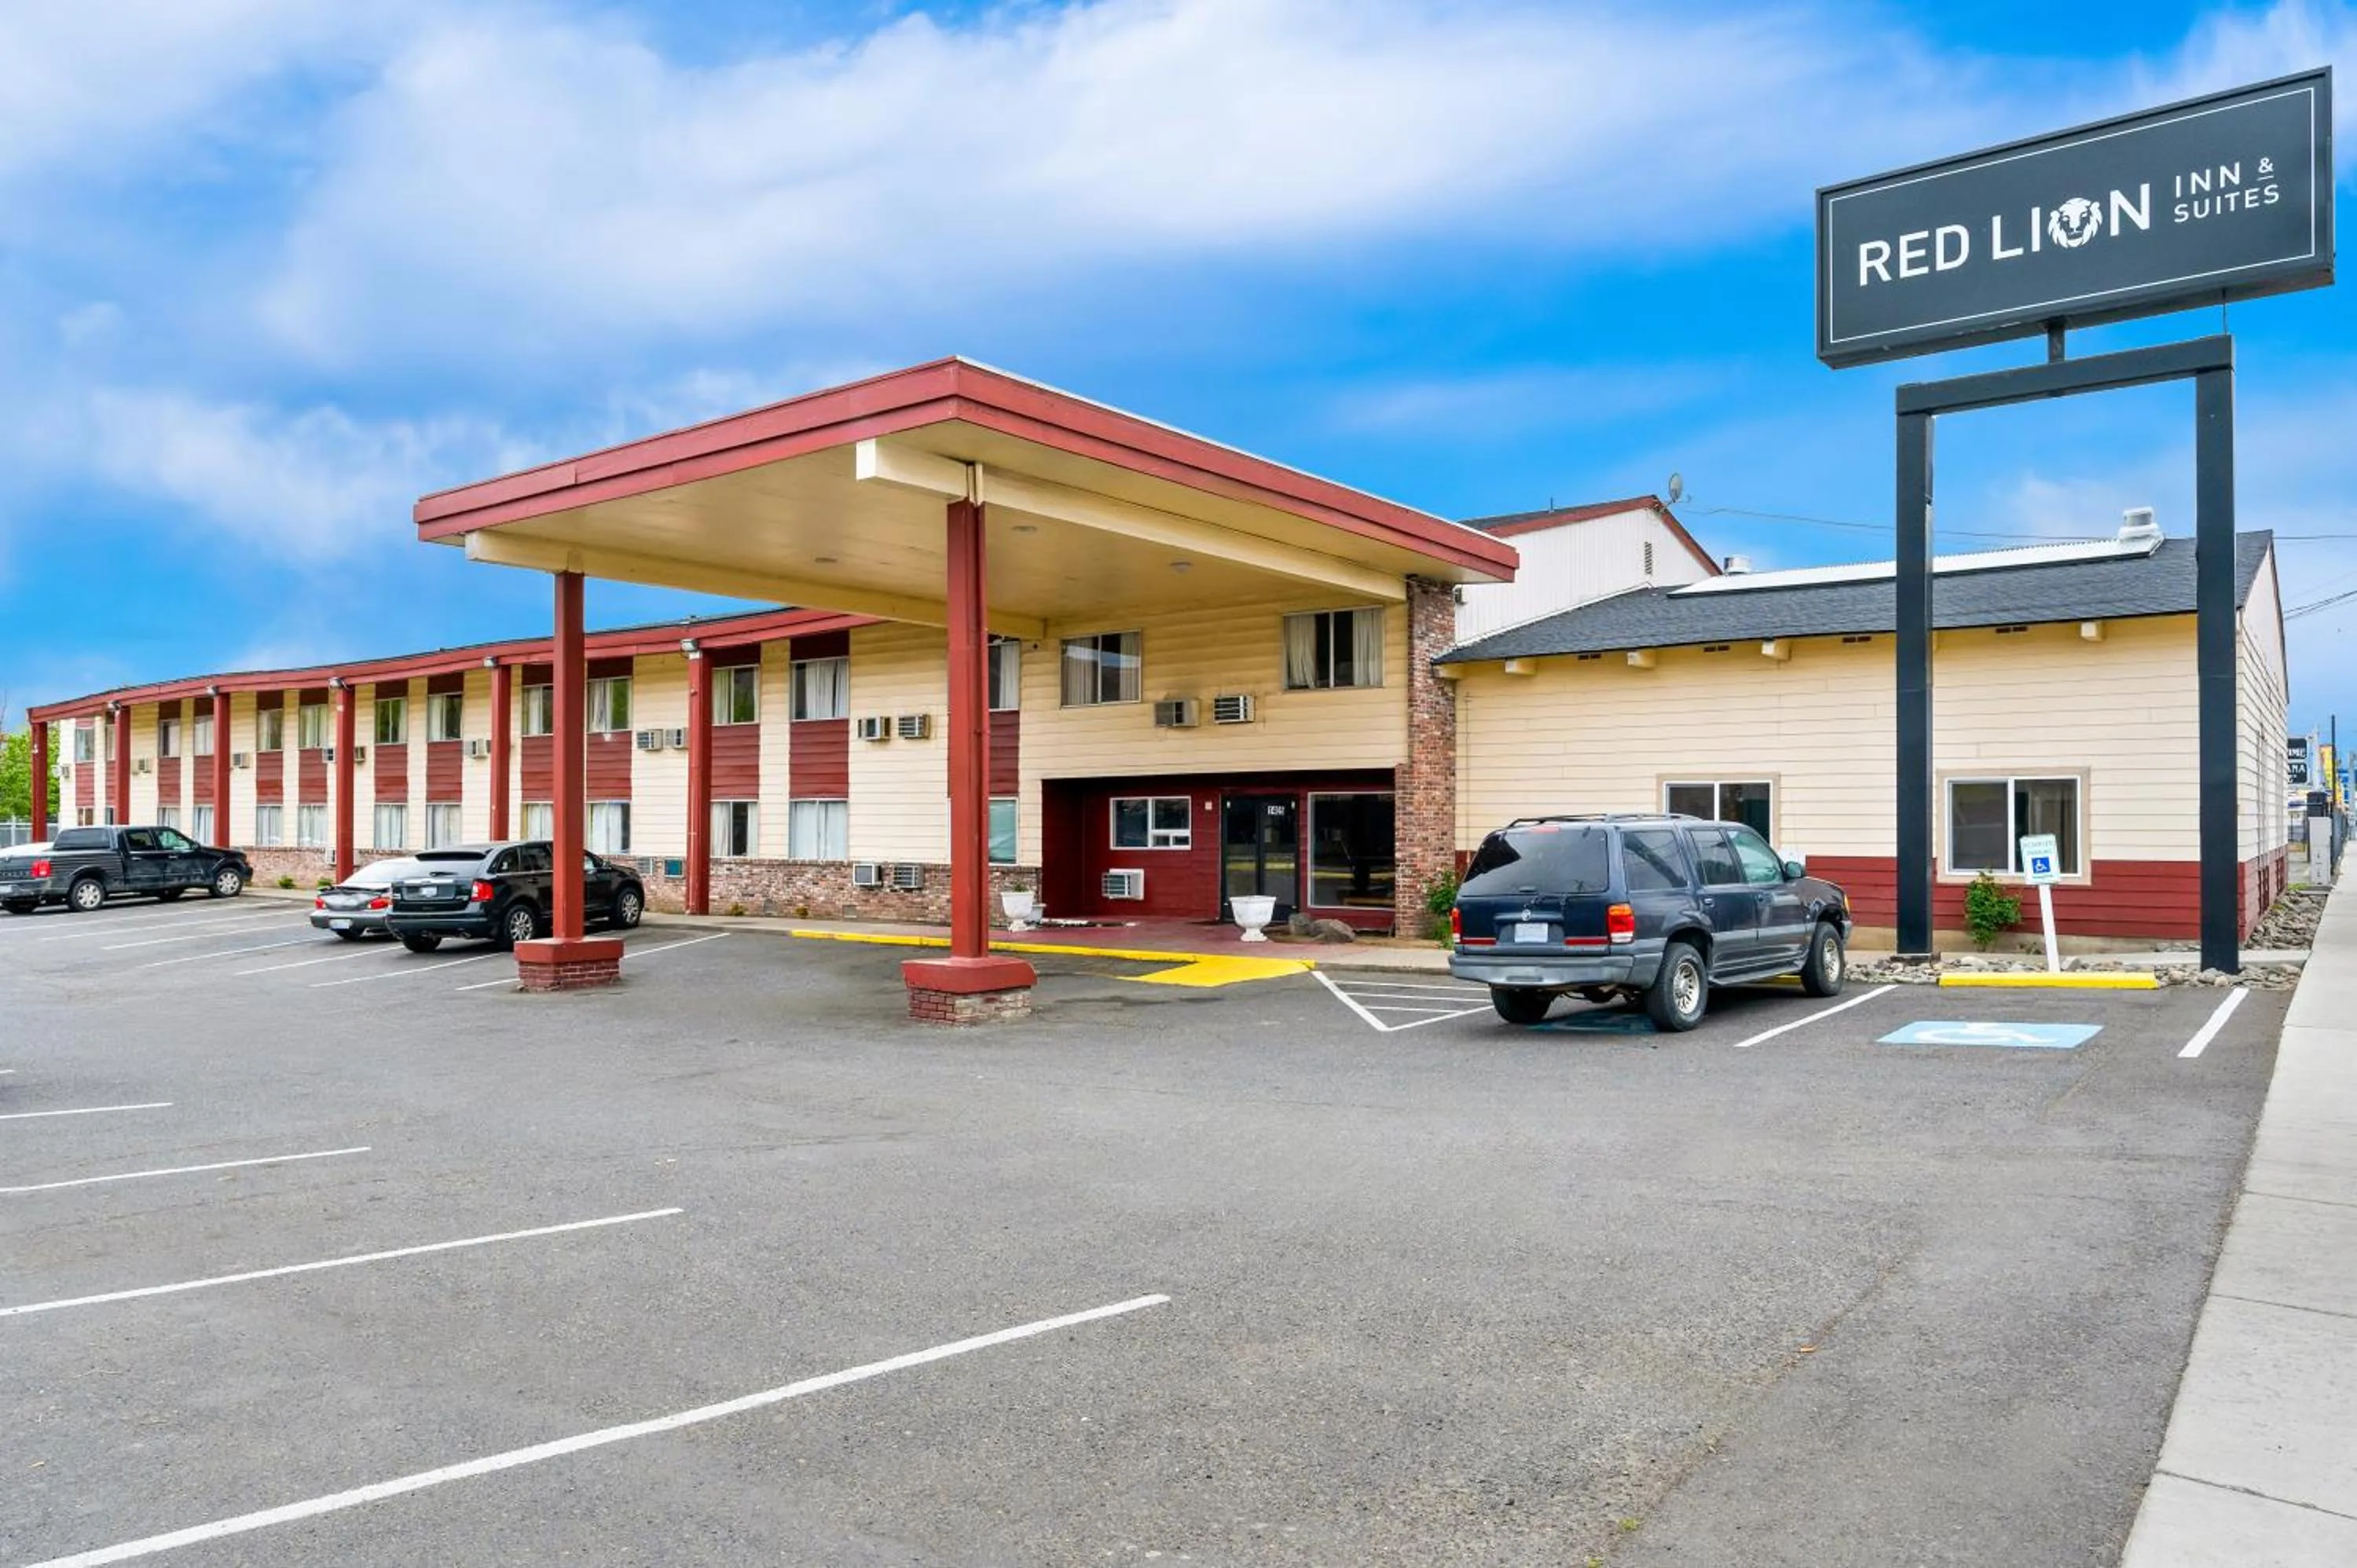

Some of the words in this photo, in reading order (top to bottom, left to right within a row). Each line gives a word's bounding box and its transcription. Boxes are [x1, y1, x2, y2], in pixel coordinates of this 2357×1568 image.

[2175, 161, 2240, 198] INN
[2257, 156, 2274, 177] &
[2174, 184, 2279, 222] SUITES
[1859, 224, 1970, 286] RED
[1992, 183, 2150, 260] LION
